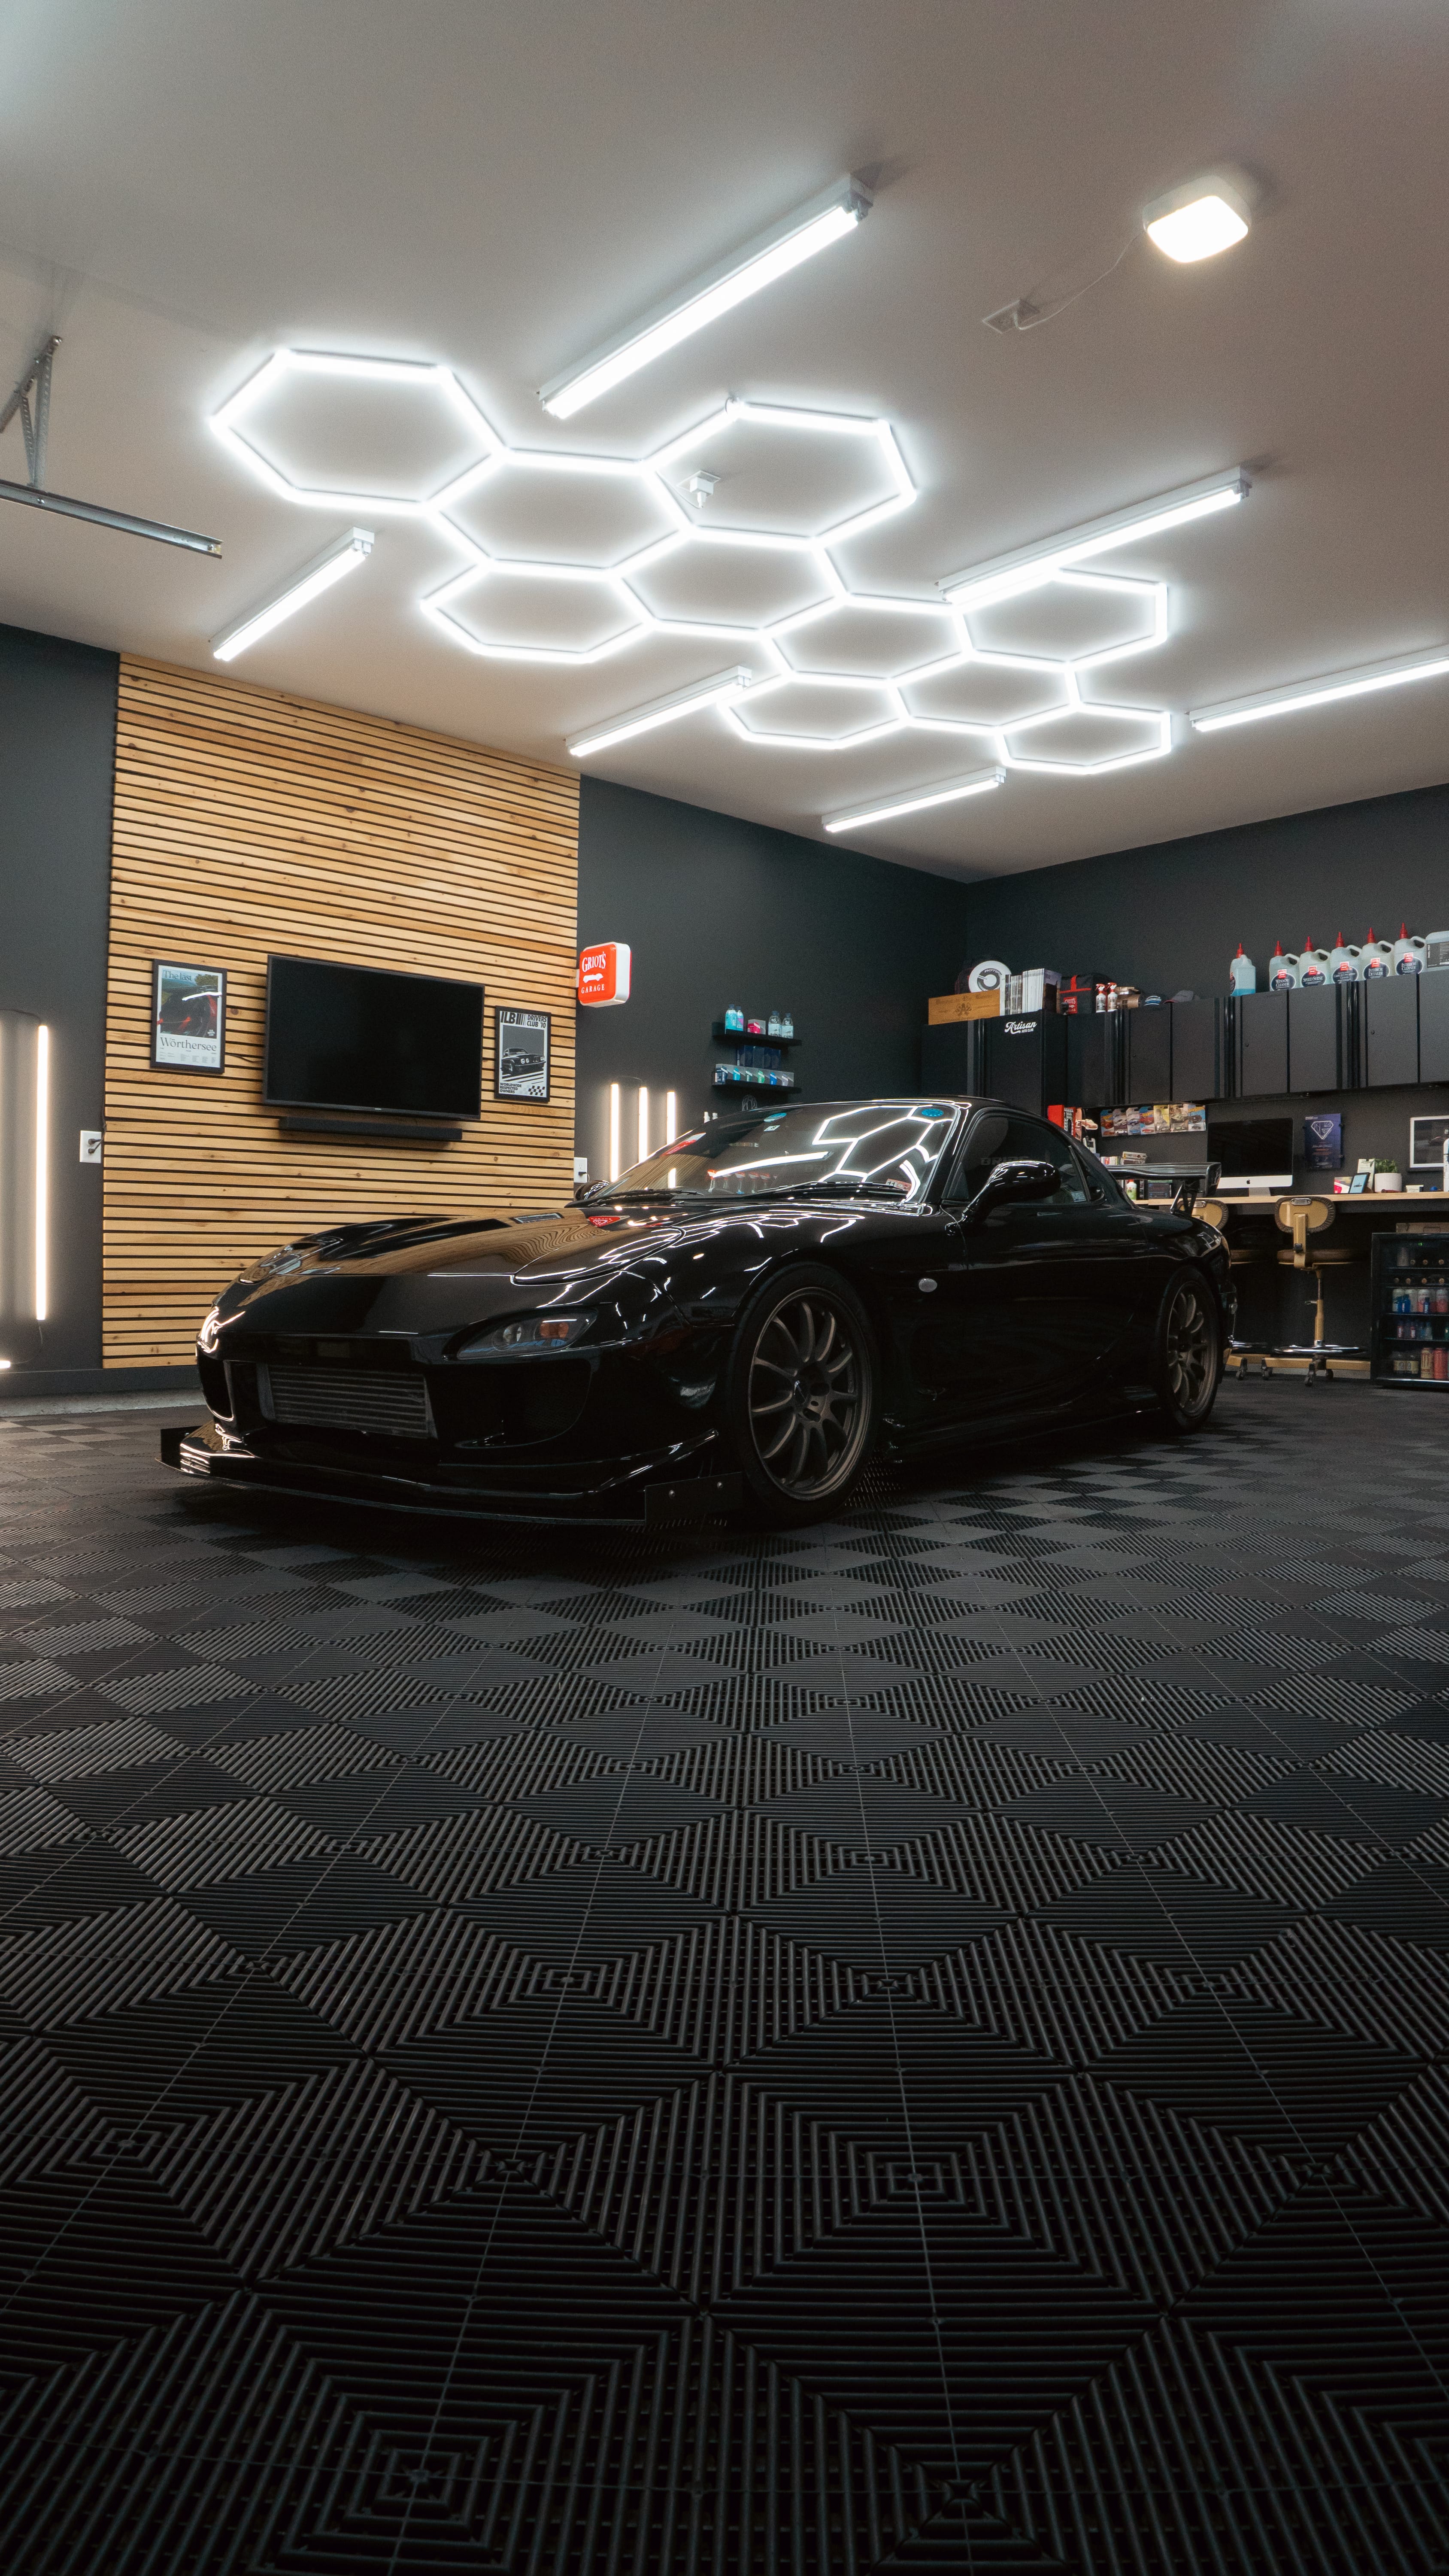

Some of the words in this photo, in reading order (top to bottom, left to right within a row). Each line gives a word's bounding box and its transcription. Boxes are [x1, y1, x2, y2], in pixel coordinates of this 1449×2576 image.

[582, 951, 606, 972] GRIOT'S
[163, 970, 179, 979] The
[180, 972, 193, 981] last
[581, 984, 605, 994] GARAGE
[1004, 1021, 1037, 1034] Artisan
